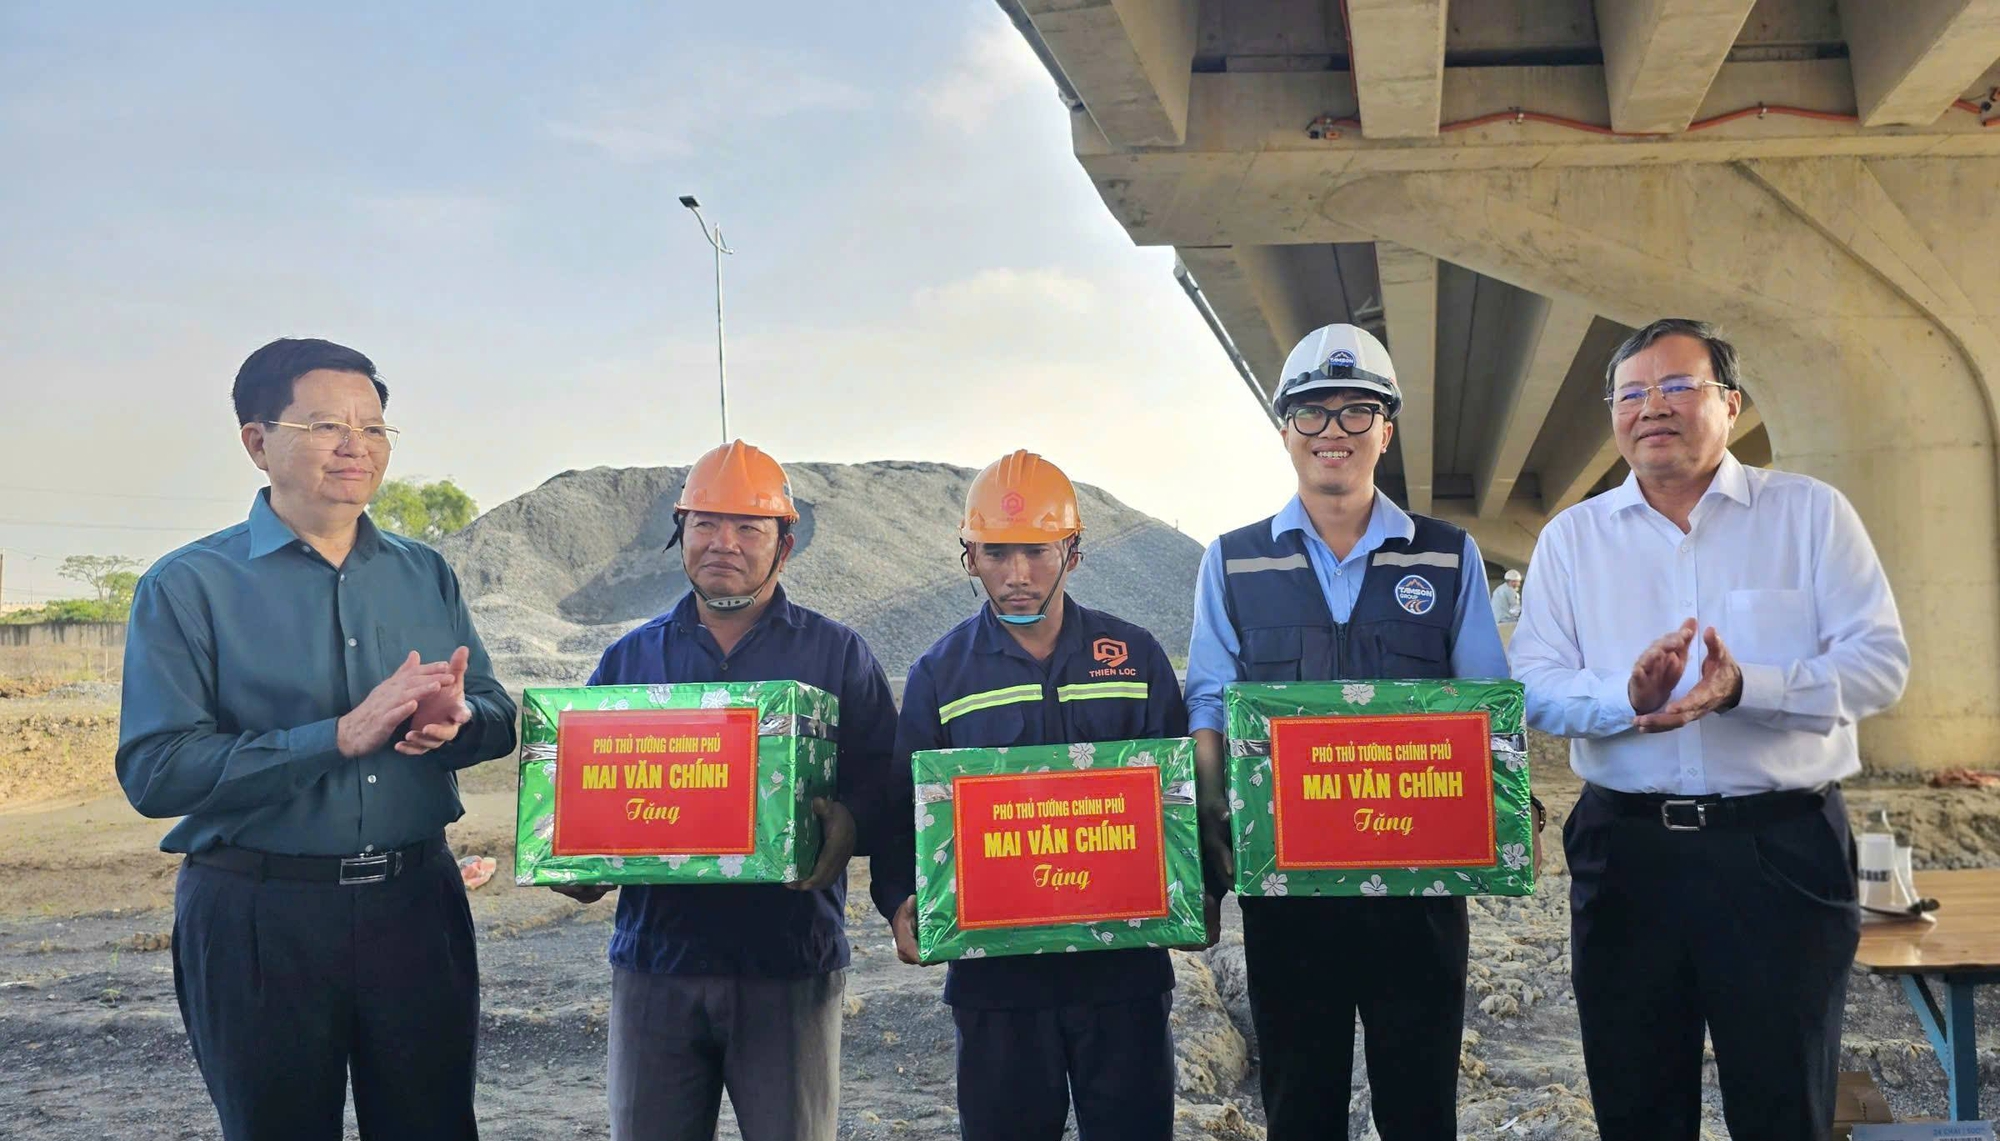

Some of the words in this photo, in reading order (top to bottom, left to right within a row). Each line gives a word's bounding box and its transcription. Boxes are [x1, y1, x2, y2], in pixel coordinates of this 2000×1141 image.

[1089, 669, 1117, 678] THIEN
[1118, 668, 1137, 676] LOC
[593, 735, 613, 754] PHÓ
[615, 733, 633, 754] THỦ
[668, 734, 699, 753] CHÍNH
[700, 732, 721, 753] PHỦ
[1311, 743, 1333, 763] PHÓ
[1336, 740, 1356, 762] THỦ
[1395, 741, 1428, 761] CHÍNH
[1430, 738, 1452, 760] PHỦ
[582, 765, 617, 789] MAI
[624, 760, 662, 789] VĂN
[669, 758, 728, 789] CHÍNH
[1303, 774, 1341, 800] MAI
[1348, 768, 1391, 799] VĂN
[1399, 766, 1463, 798] CHÍNH
[626, 798, 681, 824] Tặng
[993, 800, 1014, 820] PHÓ
[1016, 797, 1035, 819] THỦ
[1037, 798, 1070, 818] TƯỚNG
[1071, 796, 1103, 816] CHÍNH
[1105, 792, 1126, 814] PHỦ
[1353, 808, 1414, 836] Tặng
[984, 831, 1021, 858] MAI
[1028, 824, 1068, 855] VĂN
[1075, 820, 1137, 853] CHÍNH
[1033, 864, 1091, 890] Tặng
